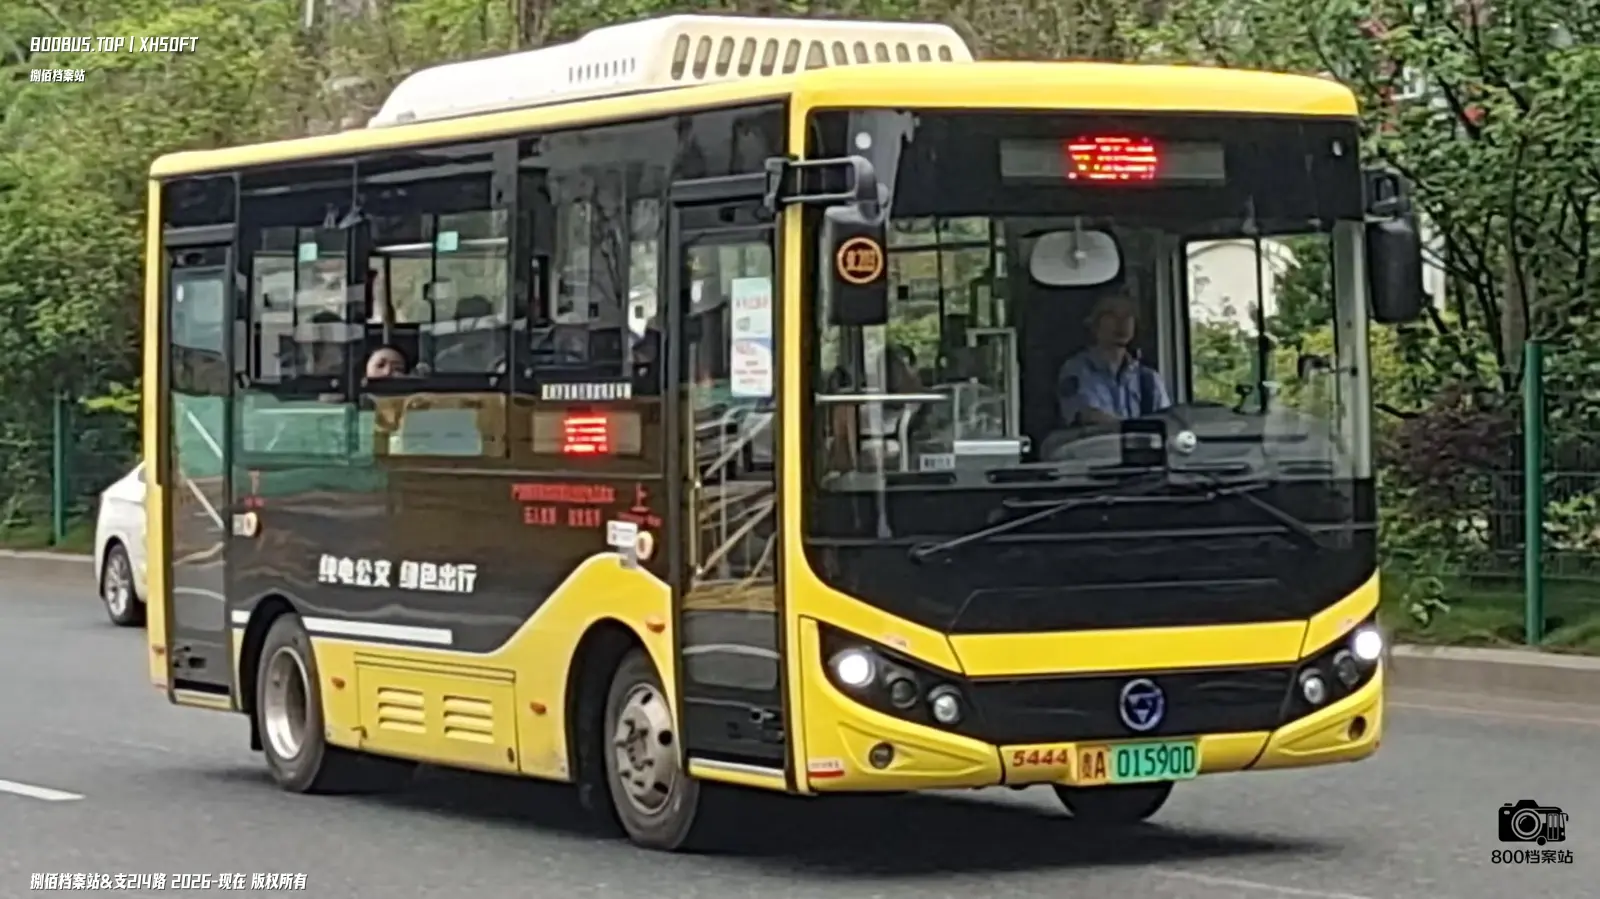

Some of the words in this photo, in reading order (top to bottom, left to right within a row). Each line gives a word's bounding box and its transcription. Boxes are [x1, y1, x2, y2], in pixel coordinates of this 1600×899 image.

[318, 553, 392, 588] 纯电公交
[399, 560, 477, 594] 绿色出行
[1013, 750, 1068, 767] 5444
[1117, 745, 1196, 777] 01590D
